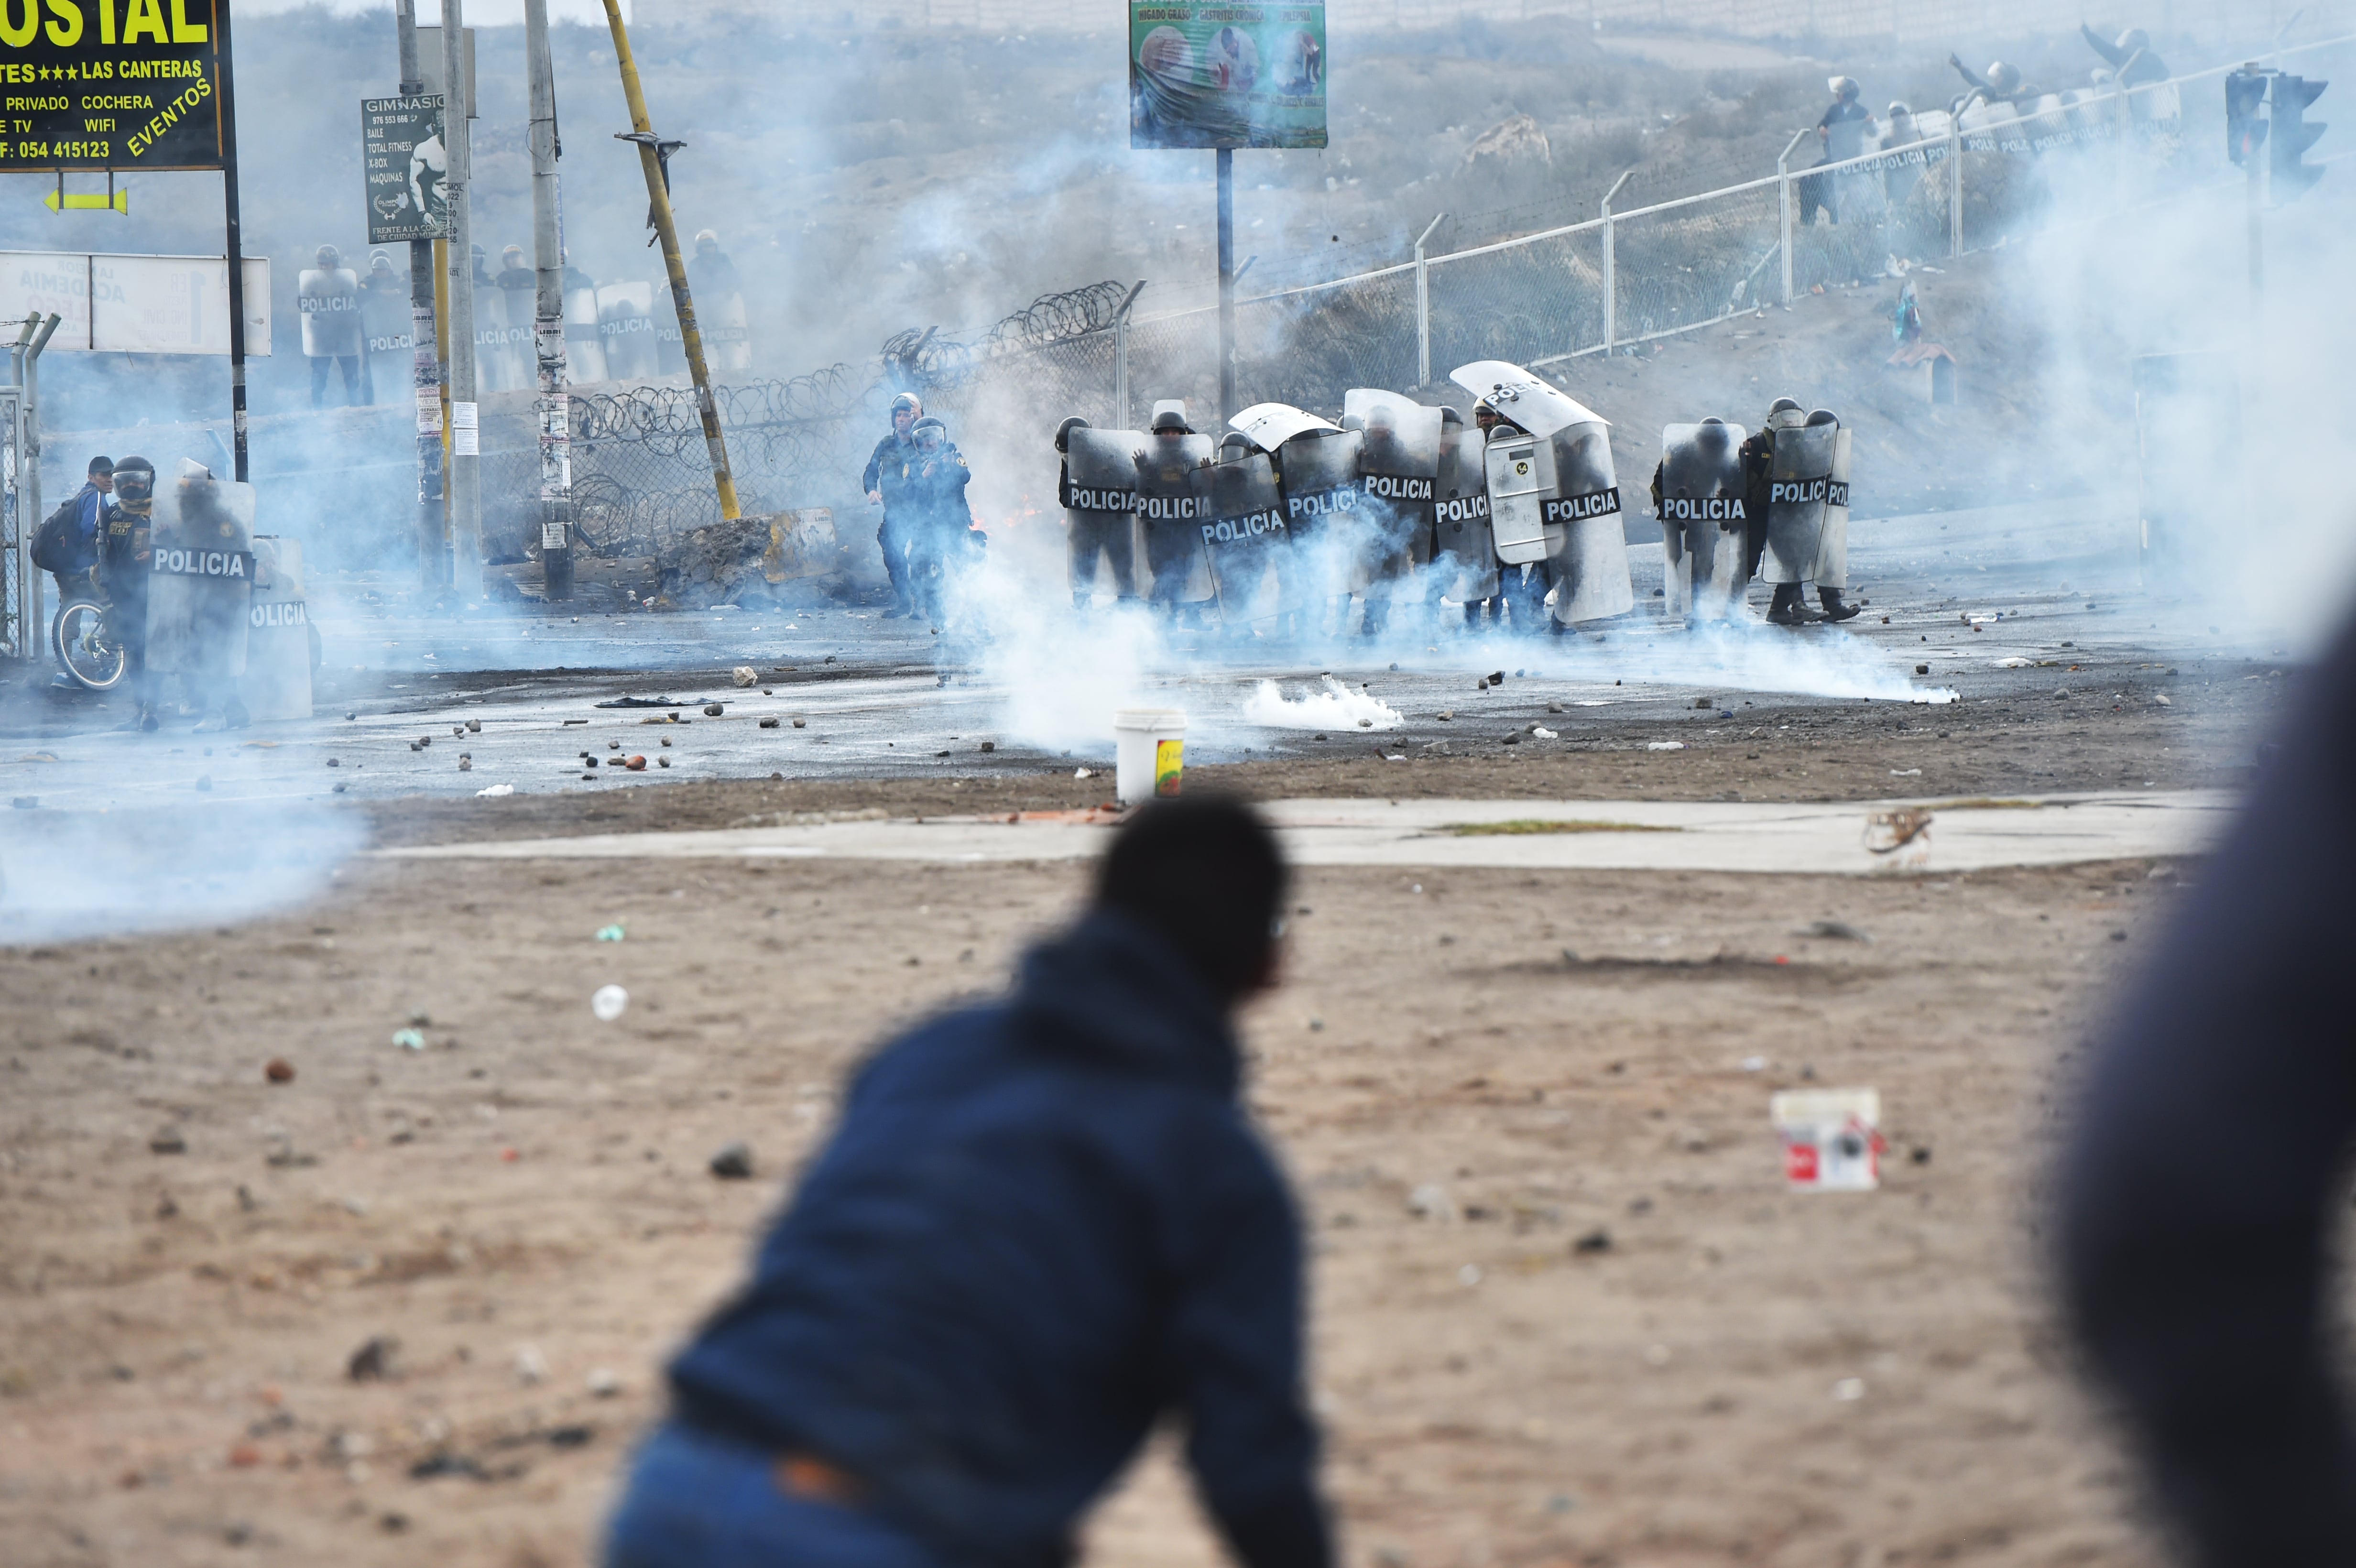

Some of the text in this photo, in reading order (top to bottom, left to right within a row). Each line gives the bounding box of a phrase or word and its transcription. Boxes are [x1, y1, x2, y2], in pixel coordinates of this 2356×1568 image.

[1168, 9, 1190, 20] GRASO
[1200, 9, 1233, 21] GASTRITIS
[82, 62, 113, 79] LAS
[119, 60, 202, 78] CANTERAS
[6, 96, 153, 110] PRIVADO COCHERA
[85, 119, 116, 132] WIFI
[127, 78, 211, 157] EVENTOS
[373, 115, 408, 125] 976 553 666
[13, 120, 32, 133] TV
[367, 128, 383, 138] BAILE
[20, 142, 48, 158] 054
[54, 142, 109, 157] 415123
[368, 142, 412, 153] TOTAL FITNESS
[369, 158, 388, 168] X-BOX
[373, 226, 401, 234] FRENTE
[301, 296, 358, 312] POLICIA
[370, 335, 415, 352] POLICI
[1365, 476, 1431, 500] POLICIA
[1071, 488, 1136, 510] POLICIA
[1547, 491, 1617, 522] POLICIA
[1137, 496, 1211, 520] POLICIA
[1436, 495, 1490, 523] POLICI
[1665, 499, 1746, 519] POLICIA
[1201, 509, 1285, 545] POLICIA
[155, 549, 244, 577] POLICIA
